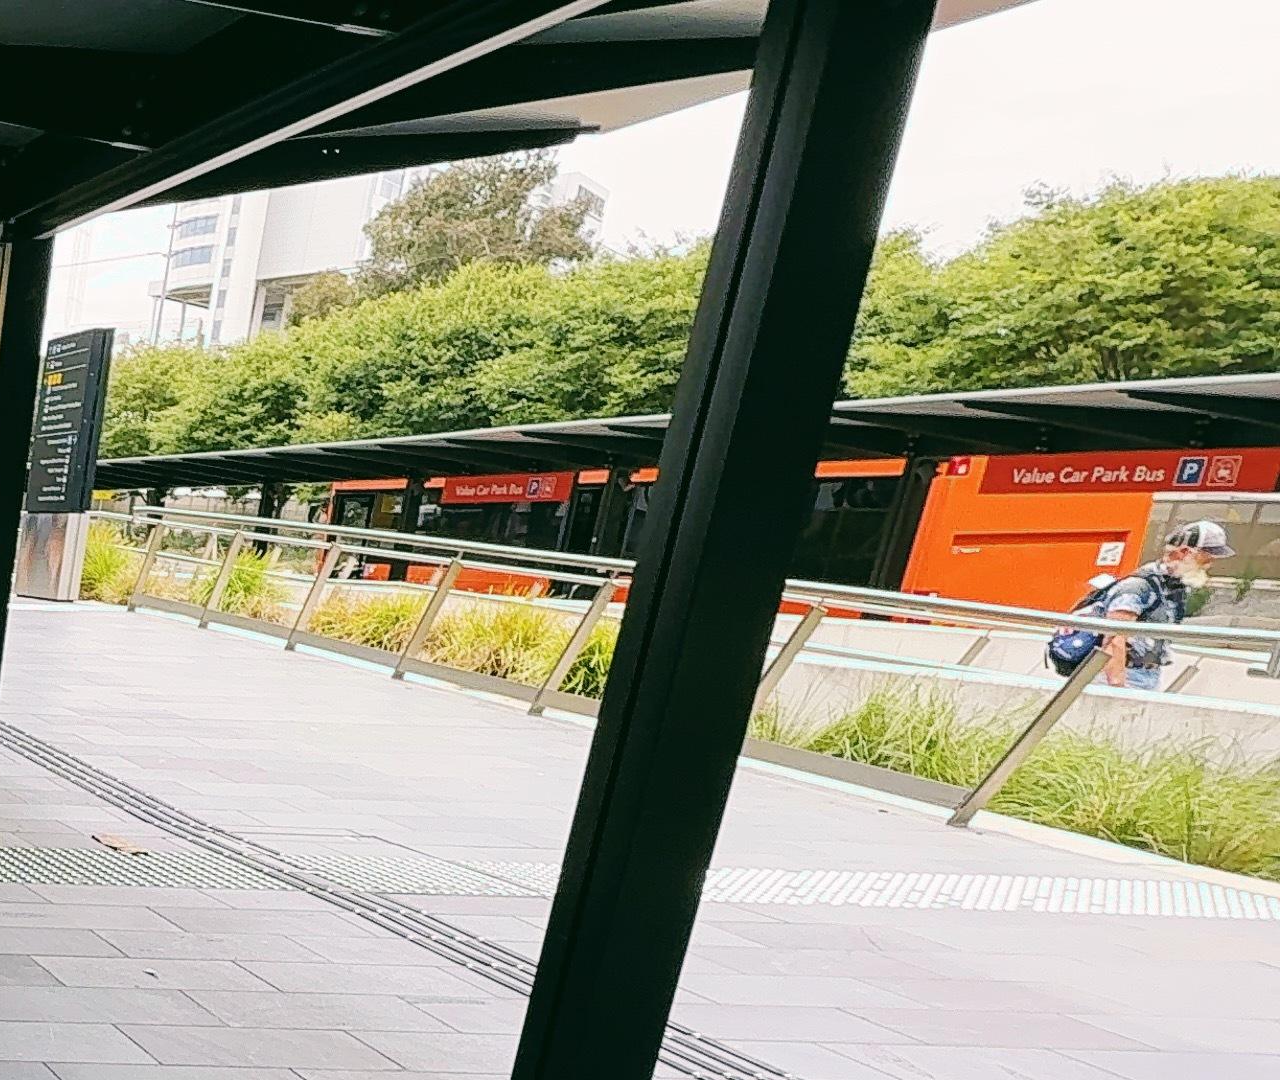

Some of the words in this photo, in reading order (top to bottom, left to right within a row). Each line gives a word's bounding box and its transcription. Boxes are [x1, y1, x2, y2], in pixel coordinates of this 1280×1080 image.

[1013, 467, 1055, 484] Value
[1059, 466, 1089, 483] Car
[1091, 465, 1129, 483] Park
[1133, 465, 1165, 482] Bus
[476, 485, 490, 496] Car
